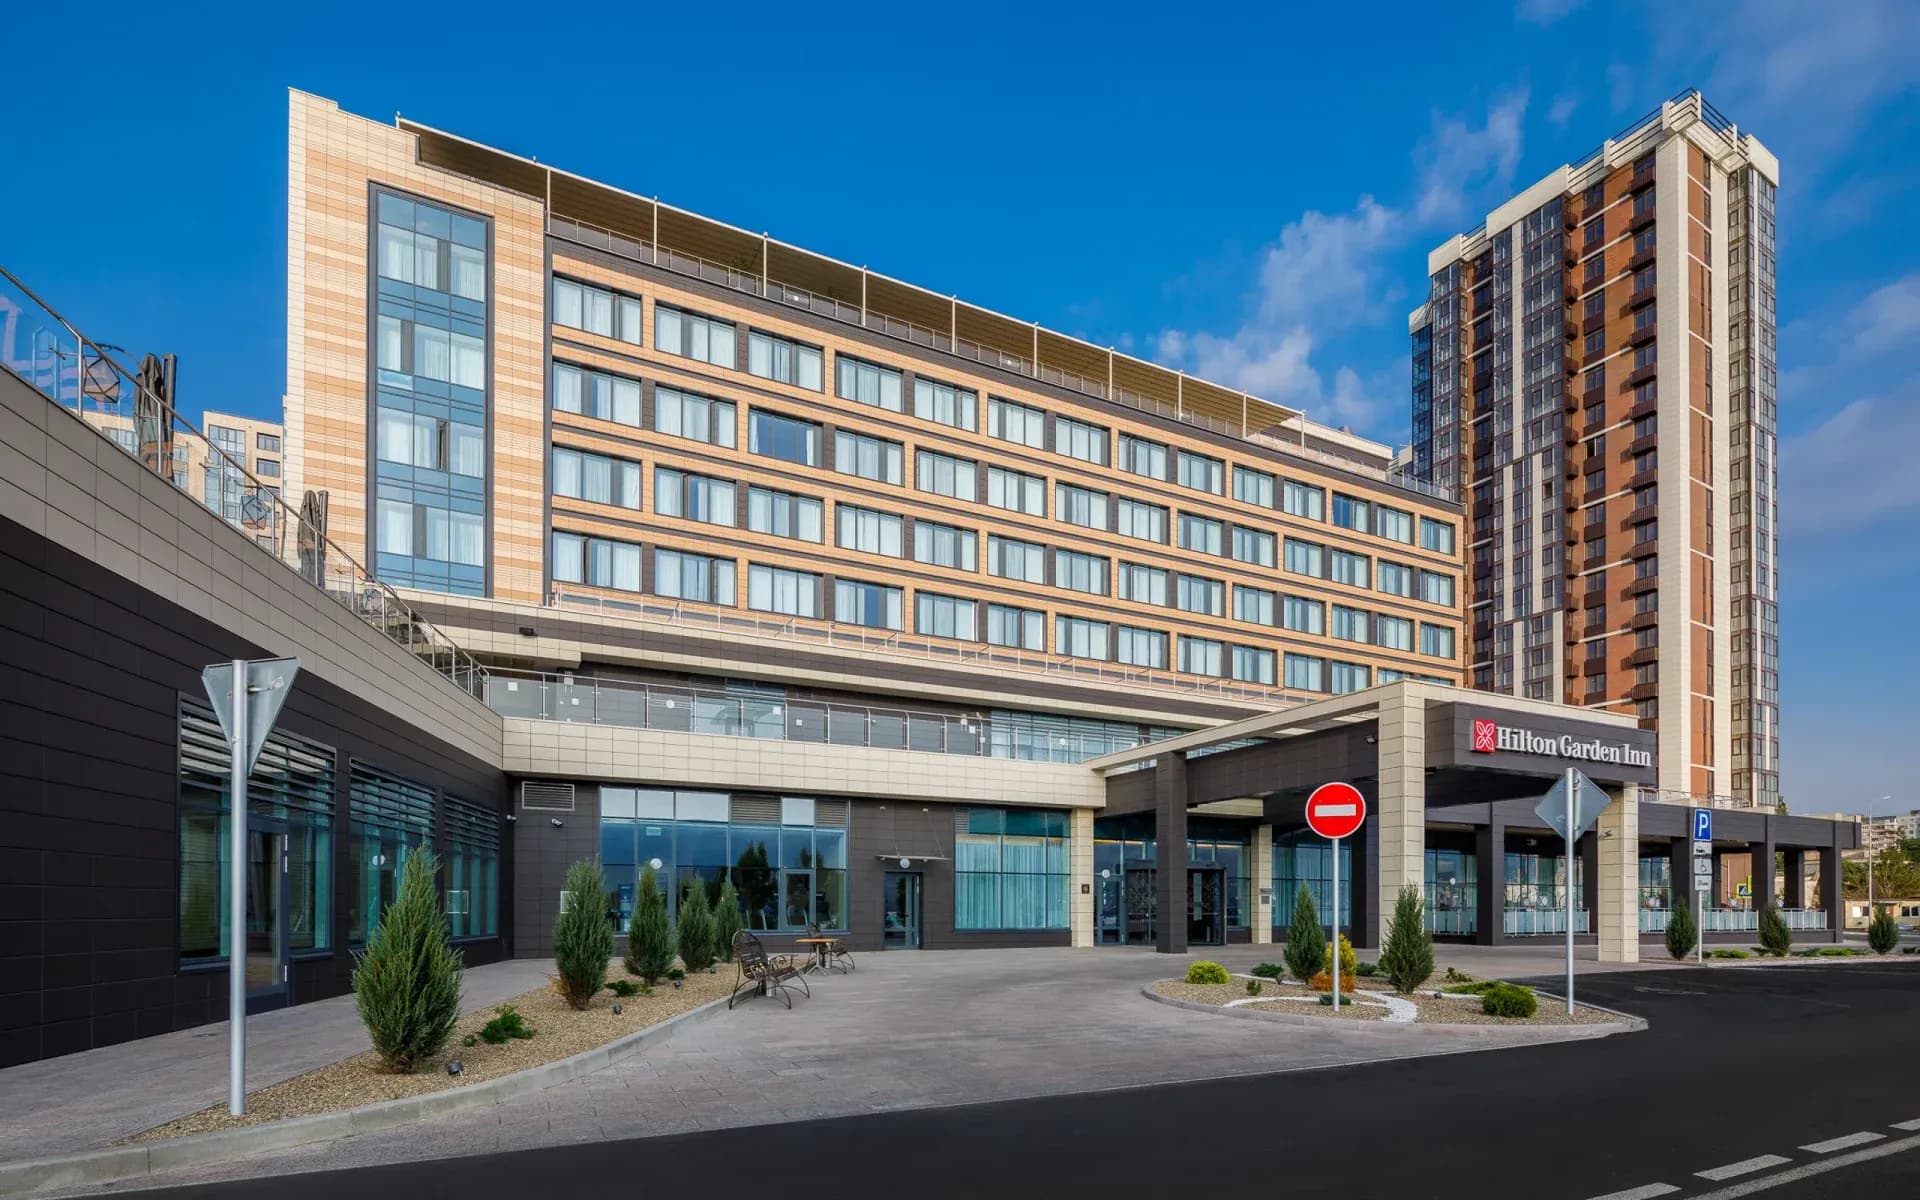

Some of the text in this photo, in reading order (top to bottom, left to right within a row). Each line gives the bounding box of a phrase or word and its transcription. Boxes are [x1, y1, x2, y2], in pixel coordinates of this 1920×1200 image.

[1496, 726, 1651, 767] Hilton Garden Inn
[1698, 813, 1709, 837] P
